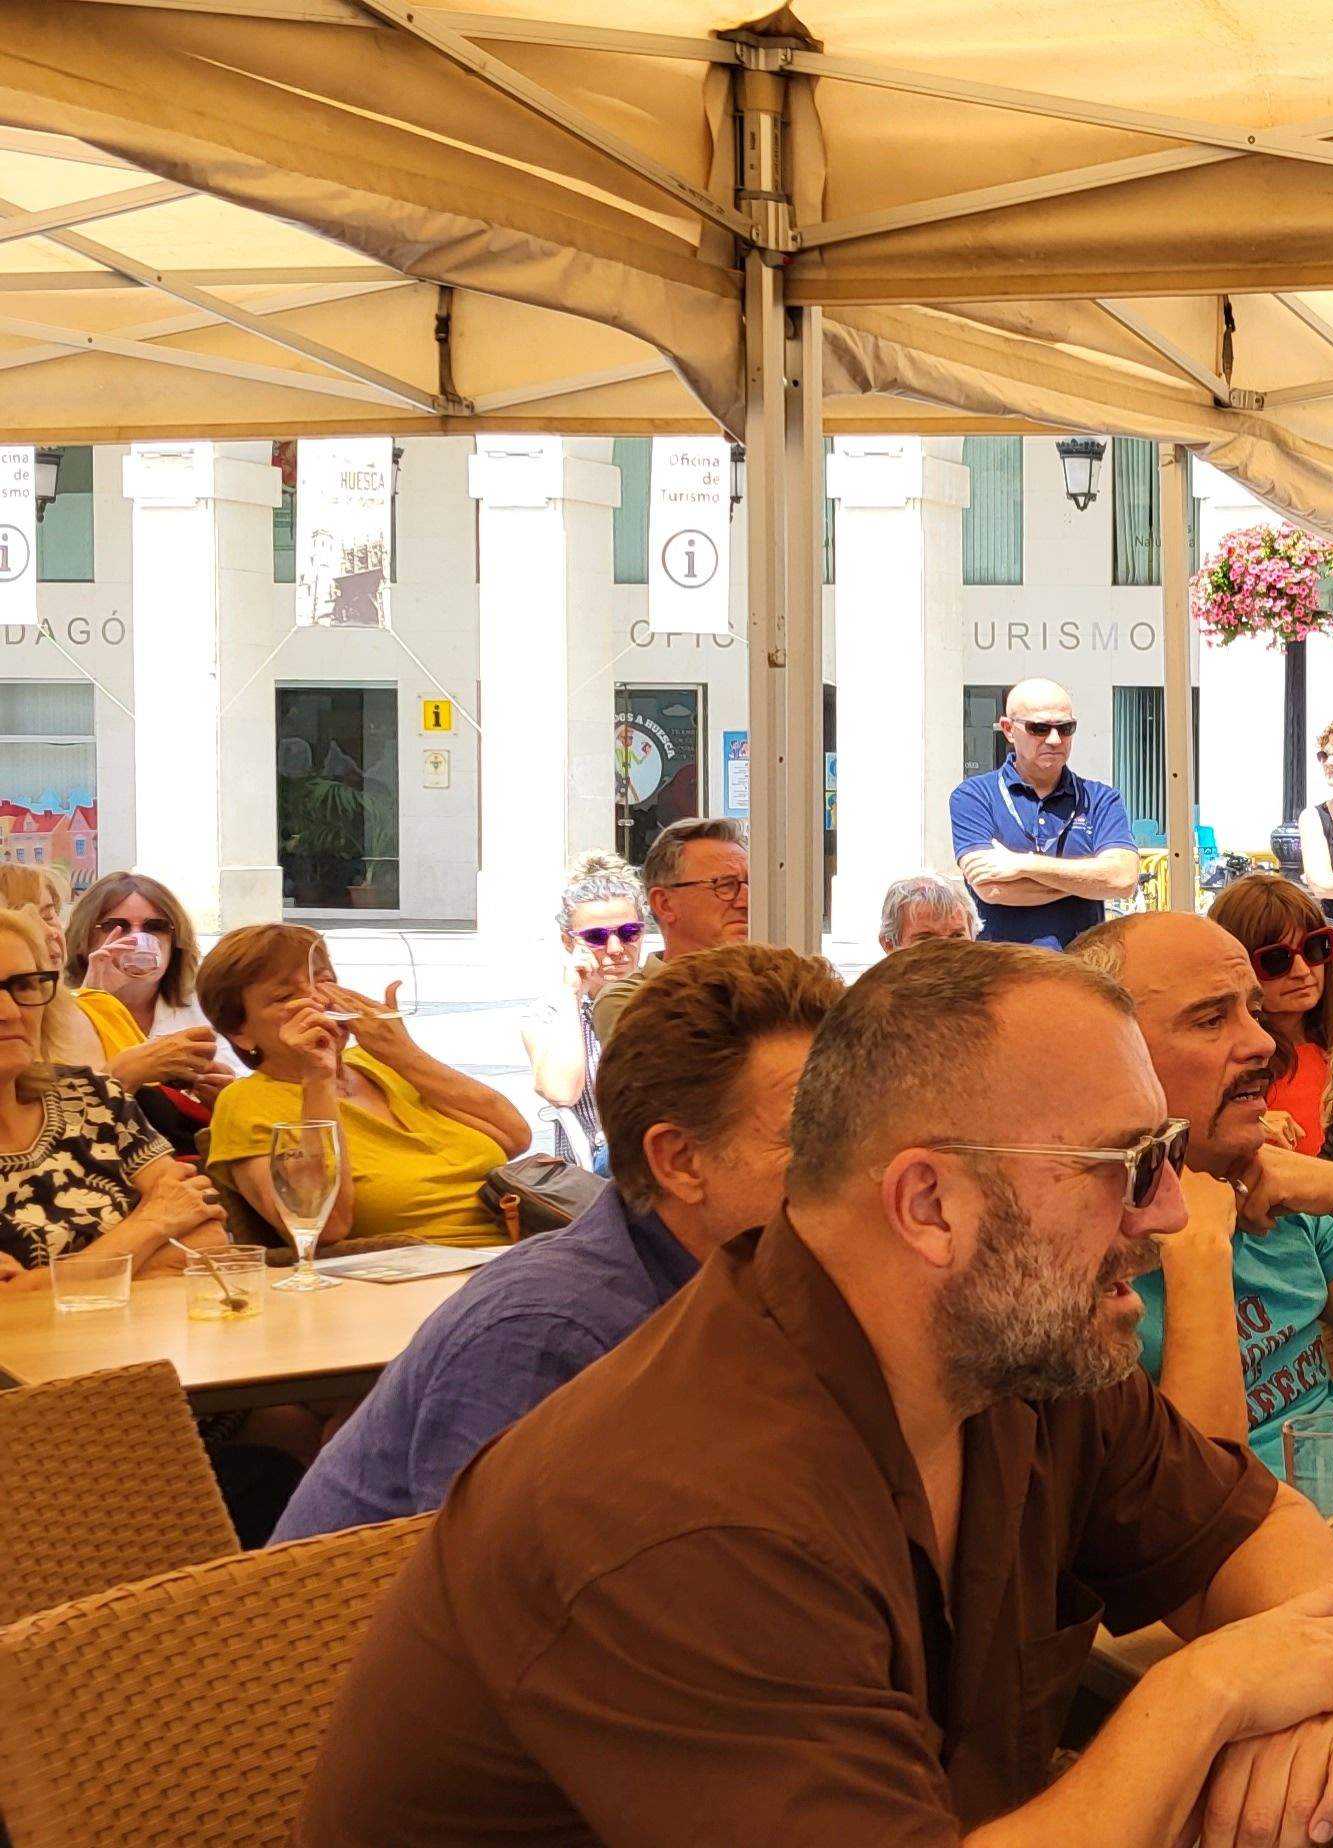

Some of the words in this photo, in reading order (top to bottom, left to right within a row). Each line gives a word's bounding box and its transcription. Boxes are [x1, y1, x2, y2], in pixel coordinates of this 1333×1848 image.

[1, 453, 30, 464] cina
[669, 453, 720, 467] Oficina
[13, 469, 30, 481] de
[340, 471, 385, 491] HUESCA
[702, 472, 720, 485] de
[661, 489, 720, 503] Turismo
[5, 610, 126, 645] DAGÓ
[630, 619, 735, 648] OFIC
[974, 621, 1156, 651] URISMO
[644, 719, 675, 759] HUESCA
